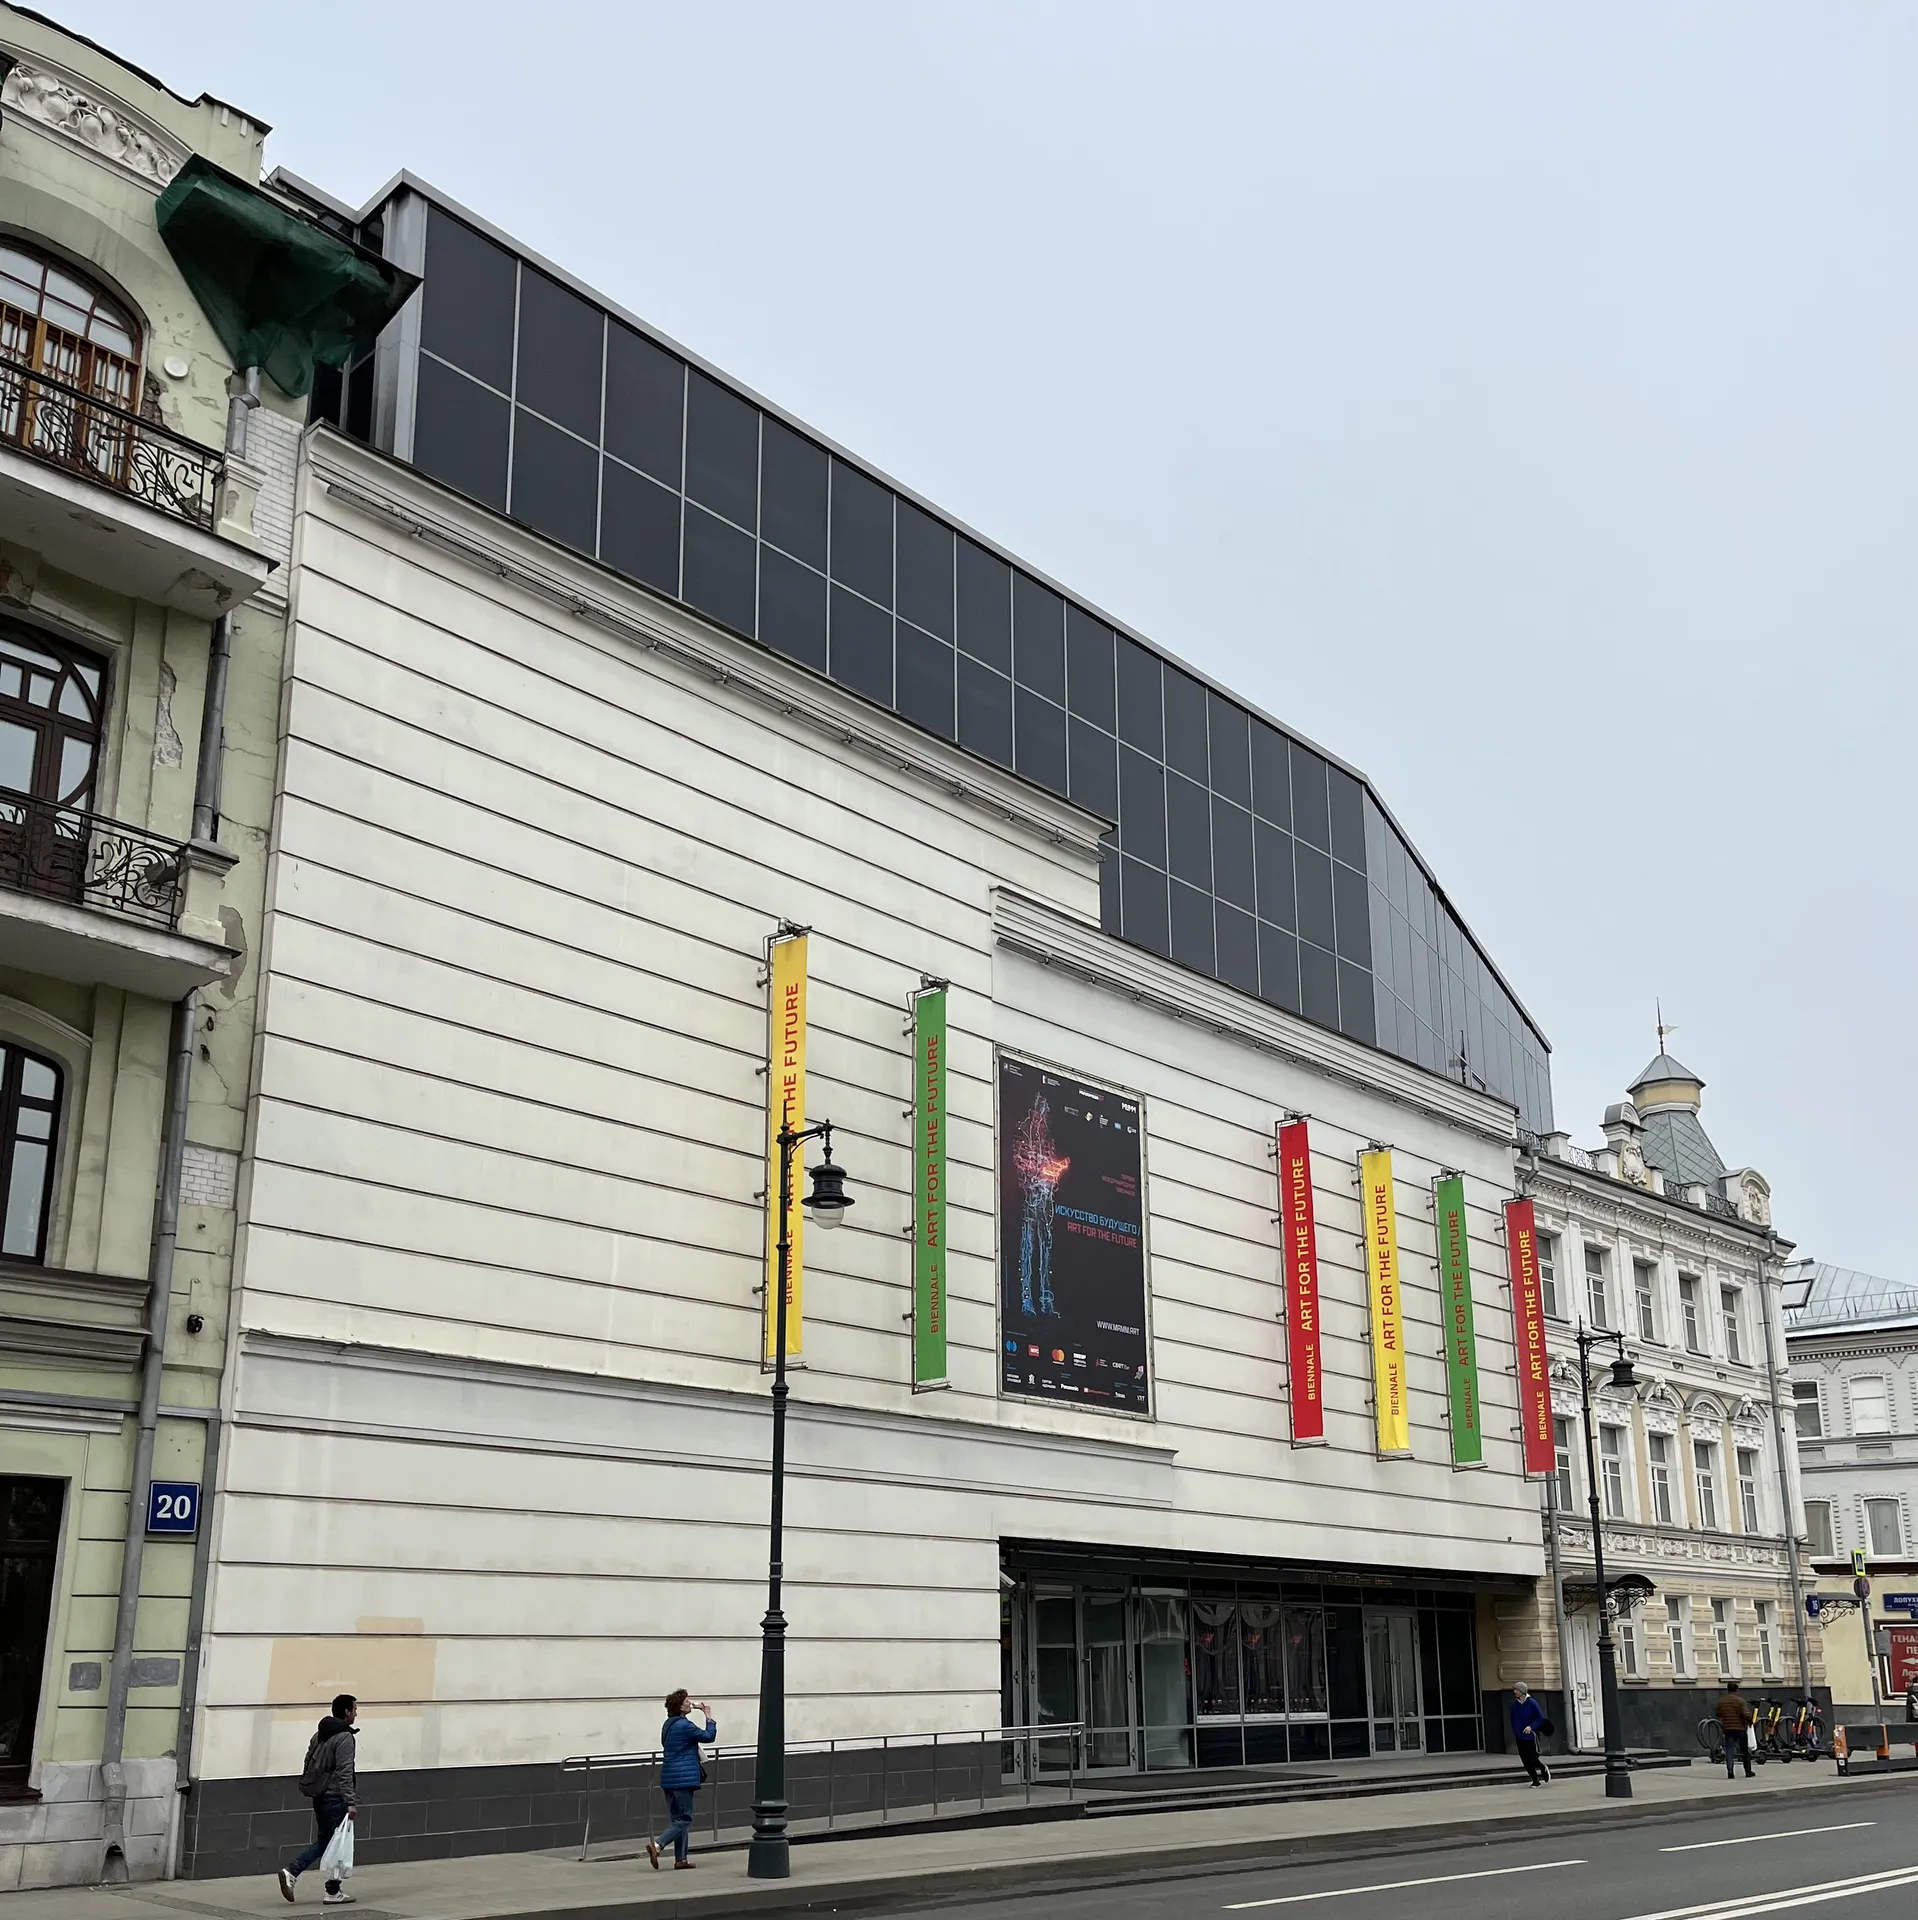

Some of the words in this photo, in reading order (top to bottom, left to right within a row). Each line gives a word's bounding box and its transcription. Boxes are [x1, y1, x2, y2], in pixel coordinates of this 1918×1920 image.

[784, 983, 800, 1067] FUTURE
[927, 1033, 939, 1113] FUTURE
[928, 1117, 939, 1156] THE
[928, 1161, 939, 1203] FOR
[1292, 1156, 1308, 1222] FUTURE
[927, 1210, 938, 1248] ART
[1055, 1204, 1099, 1225] ИСКУССТВО
[1099, 1215, 1137, 1236] БУДУЩЕГО
[1375, 1184, 1389, 1246] FUTURE
[1067, 1221, 1083, 1235] ART
[1082, 1225, 1097, 1239] FOR
[1097, 1229, 1111, 1242] THE
[1111, 1232, 1138, 1248] FUTURE
[1297, 1225, 1309, 1261] THE
[1448, 1209, 1461, 1267] FUTURE
[1379, 1250, 1391, 1281] THE
[1519, 1229, 1534, 1285] FUTURE
[1298, 1262, 1311, 1297] FOR
[1453, 1270, 1464, 1301] THE
[930, 1263, 939, 1334] BIENNALE
[1300, 1298, 1313, 1331] ART
[1381, 1285, 1394, 1318] FOR
[1524, 1288, 1537, 1318] THE
[1383, 1319, 1396, 1351] ART
[1455, 1303, 1467, 1334] FOR
[1527, 1320, 1540, 1349] FOR
[1457, 1336, 1470, 1367] ART
[1530, 1352, 1543, 1381] ART
[1306, 1344, 1315, 1401] BIENNALE
[1391, 1362, 1400, 1416] BIENNALE
[1463, 1377, 1473, 1429] BIENNALE
[1536, 1390, 1548, 1440] BIENNALE
[156, 1494, 192, 1520] 20
